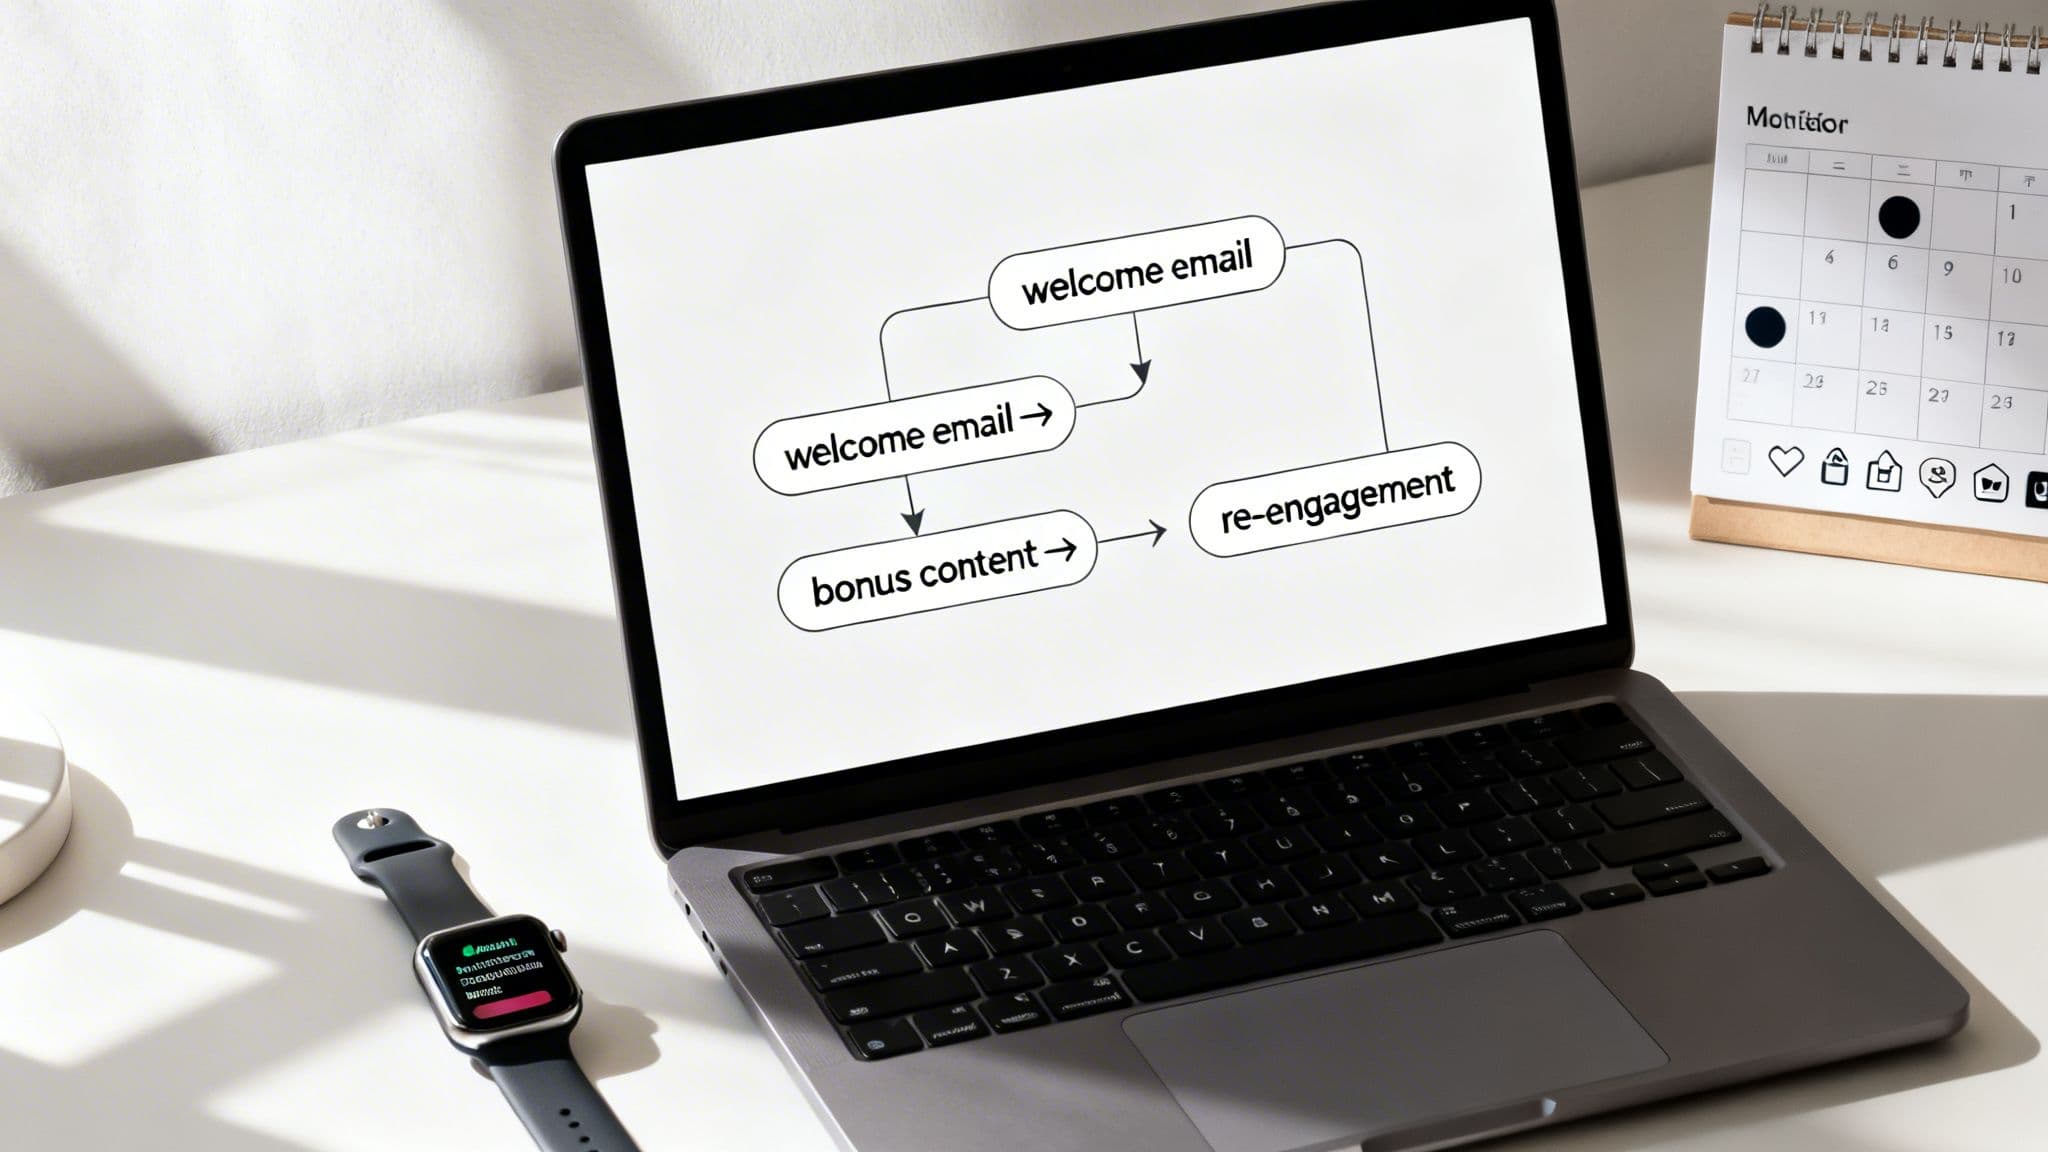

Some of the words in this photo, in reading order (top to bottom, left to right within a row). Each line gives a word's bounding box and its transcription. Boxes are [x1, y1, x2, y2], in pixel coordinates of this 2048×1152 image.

[1022, 262, 1165, 306] welcome
[1171, 237, 1253, 280] email
[1943, 260, 1954, 277] 9
[784, 423, 925, 471] welcome
[932, 401, 1014, 445] email
[1221, 465, 1456, 534] re-engagement
[811, 569, 913, 608] bonus
[918, 540, 1039, 588] content
